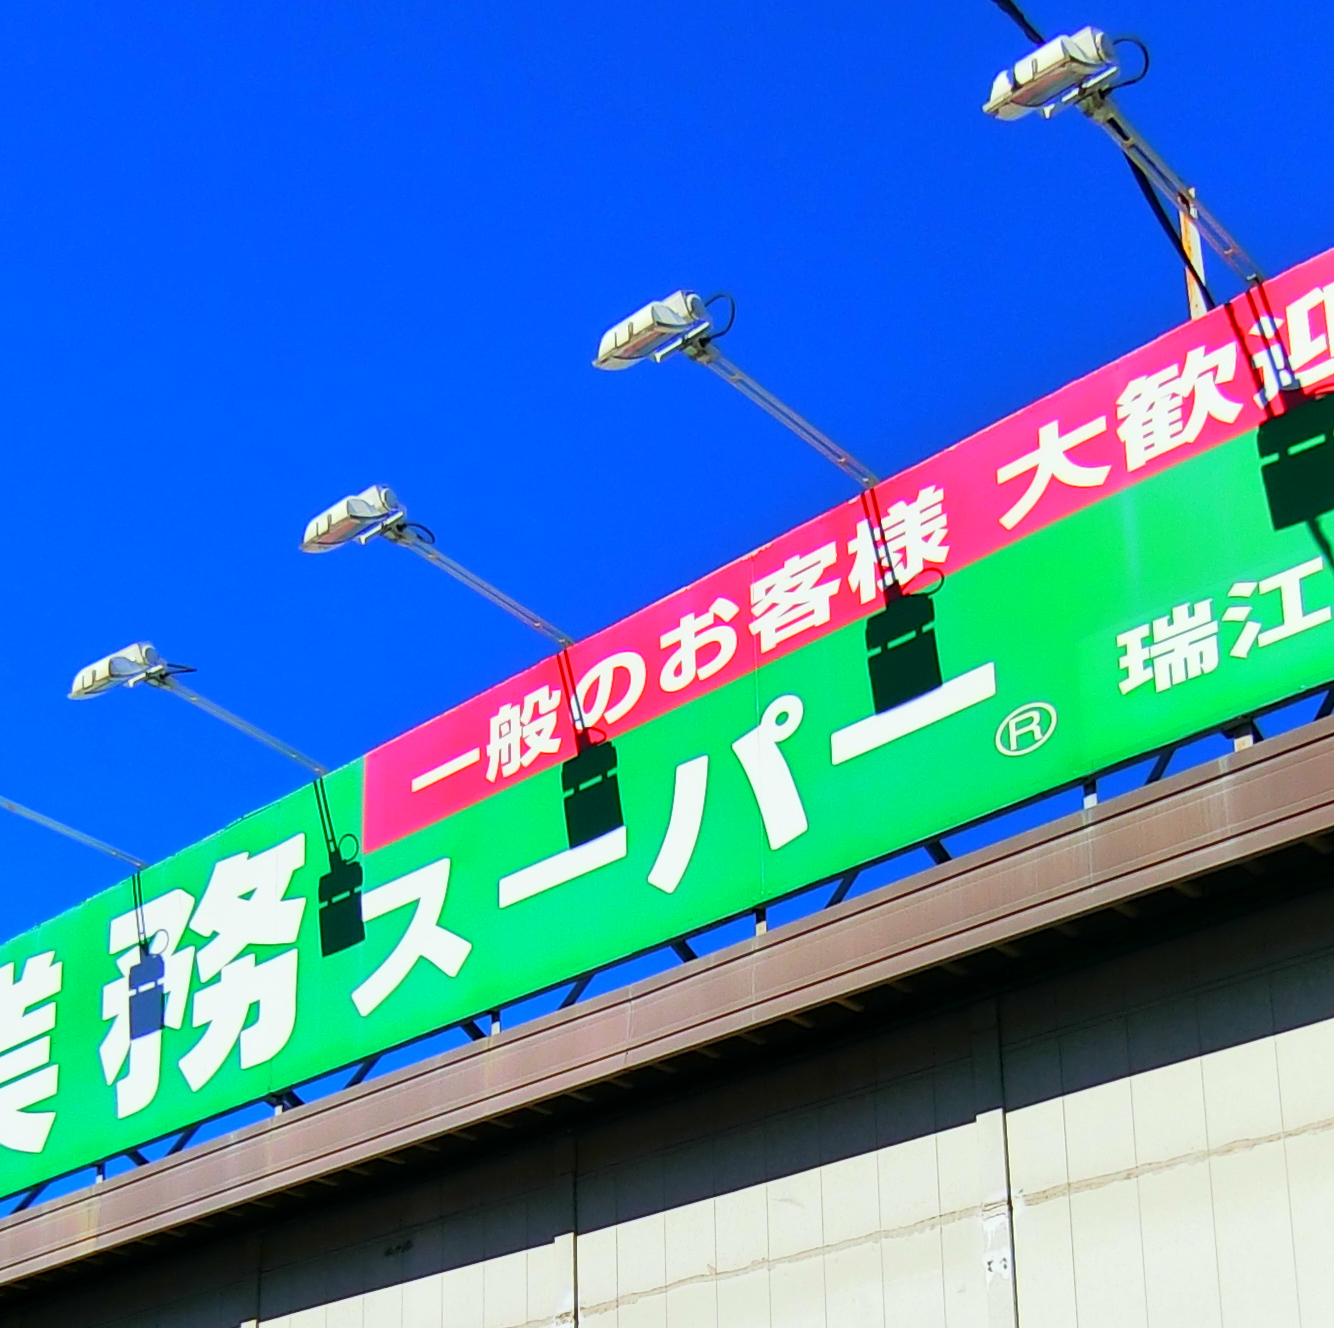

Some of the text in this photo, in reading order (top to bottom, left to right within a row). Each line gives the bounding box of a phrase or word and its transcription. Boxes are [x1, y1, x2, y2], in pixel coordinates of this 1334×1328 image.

[411, 484, 952, 792] 一般のお客様
